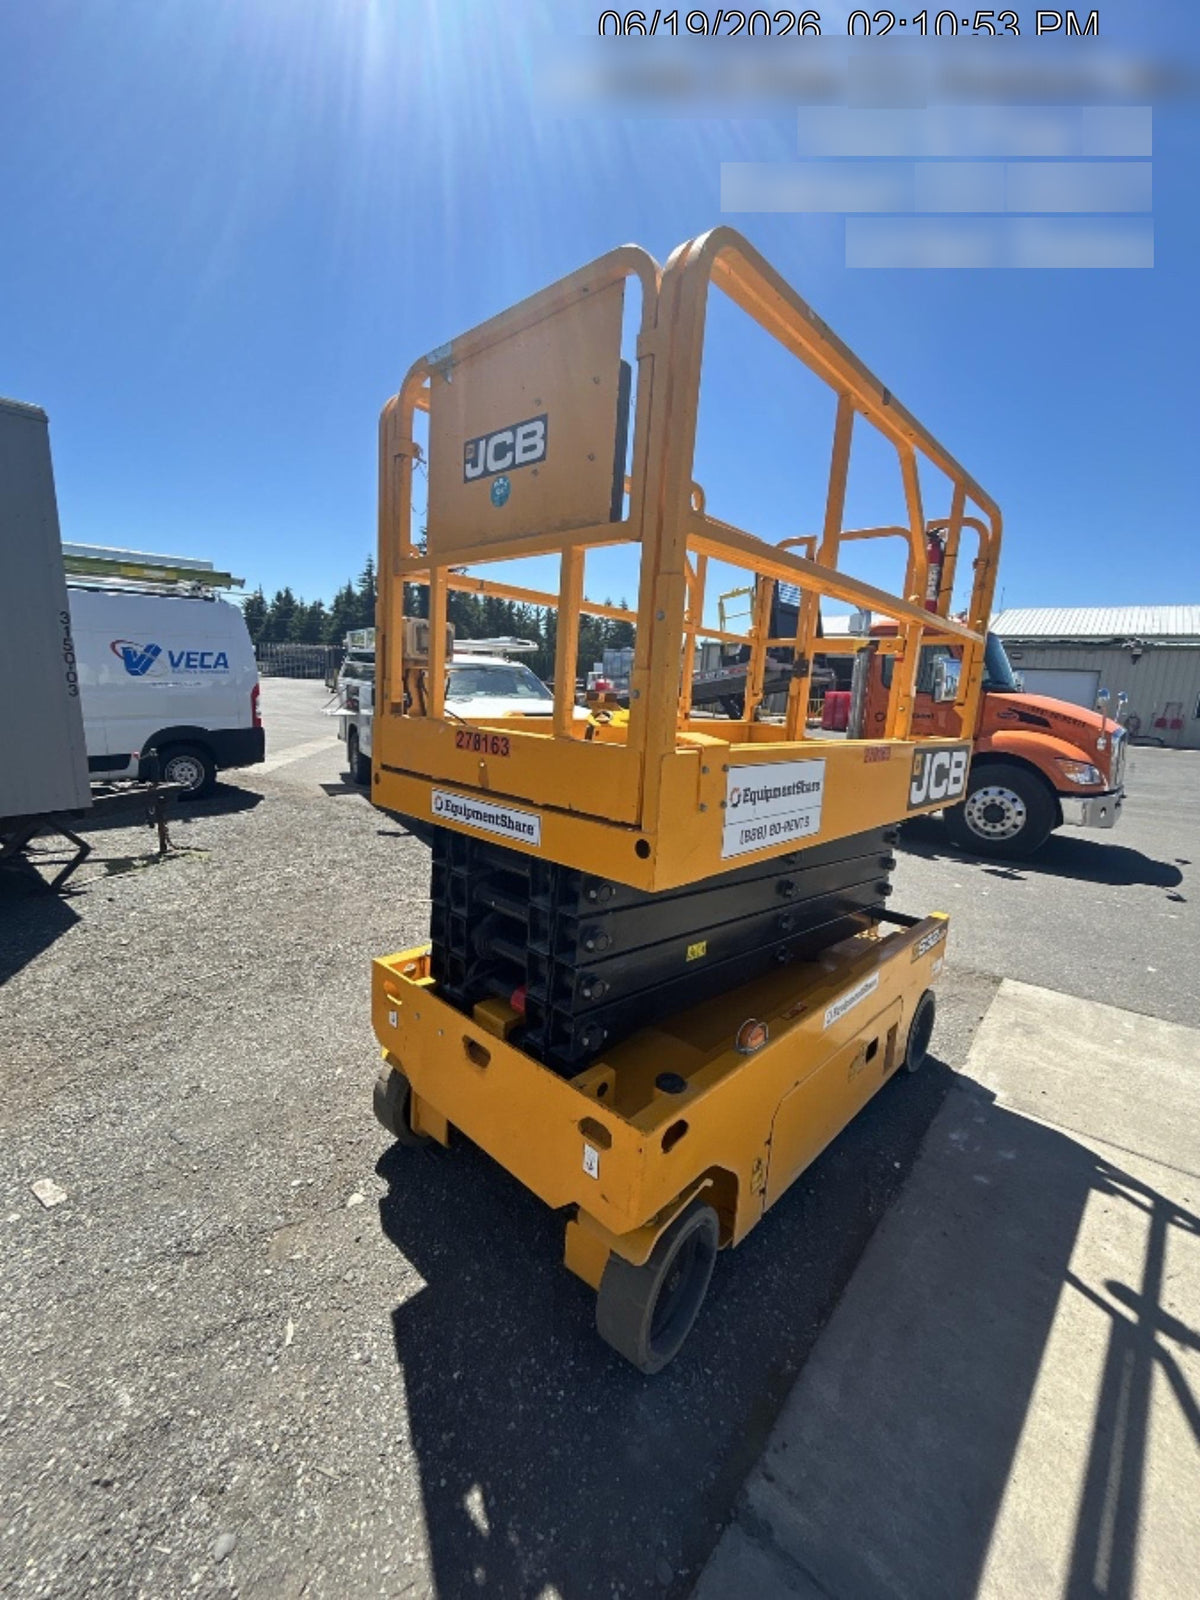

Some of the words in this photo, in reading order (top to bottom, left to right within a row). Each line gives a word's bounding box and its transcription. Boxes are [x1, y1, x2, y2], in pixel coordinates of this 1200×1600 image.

[465, 420, 545, 479] JCB
[167, 650, 230, 669] VECA
[456, 730, 510, 757] 278163
[742, 779, 821, 806] EquipmentShare
[909, 750, 968, 805] JCB
[443, 799, 535, 836] EquipmentShare
